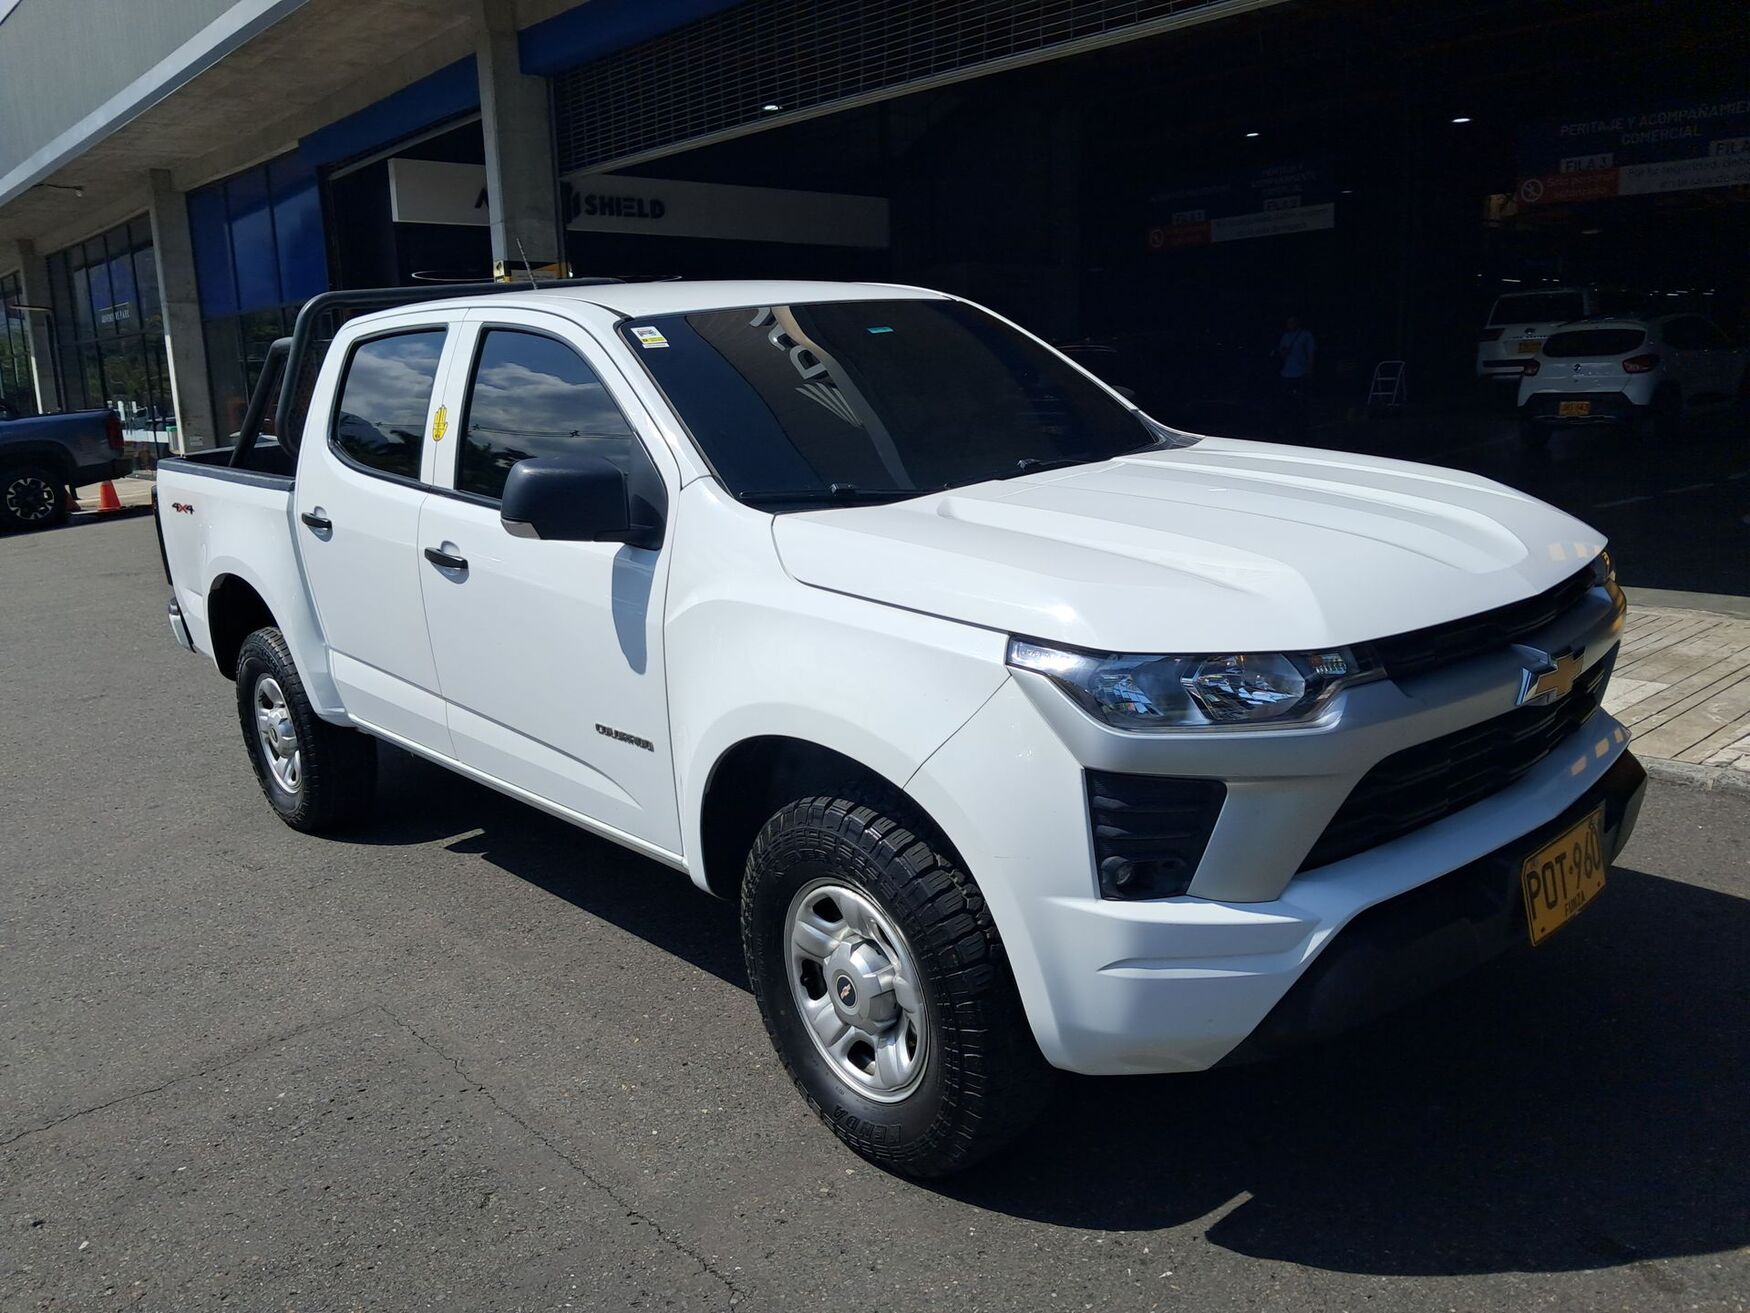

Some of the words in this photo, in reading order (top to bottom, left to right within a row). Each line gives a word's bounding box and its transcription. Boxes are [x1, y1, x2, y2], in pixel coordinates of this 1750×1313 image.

[1560, 118, 1624, 137] PERITAJE
[1621, 126, 1703, 145] COMERCIAL
[584, 193, 666, 219] SHIELD
